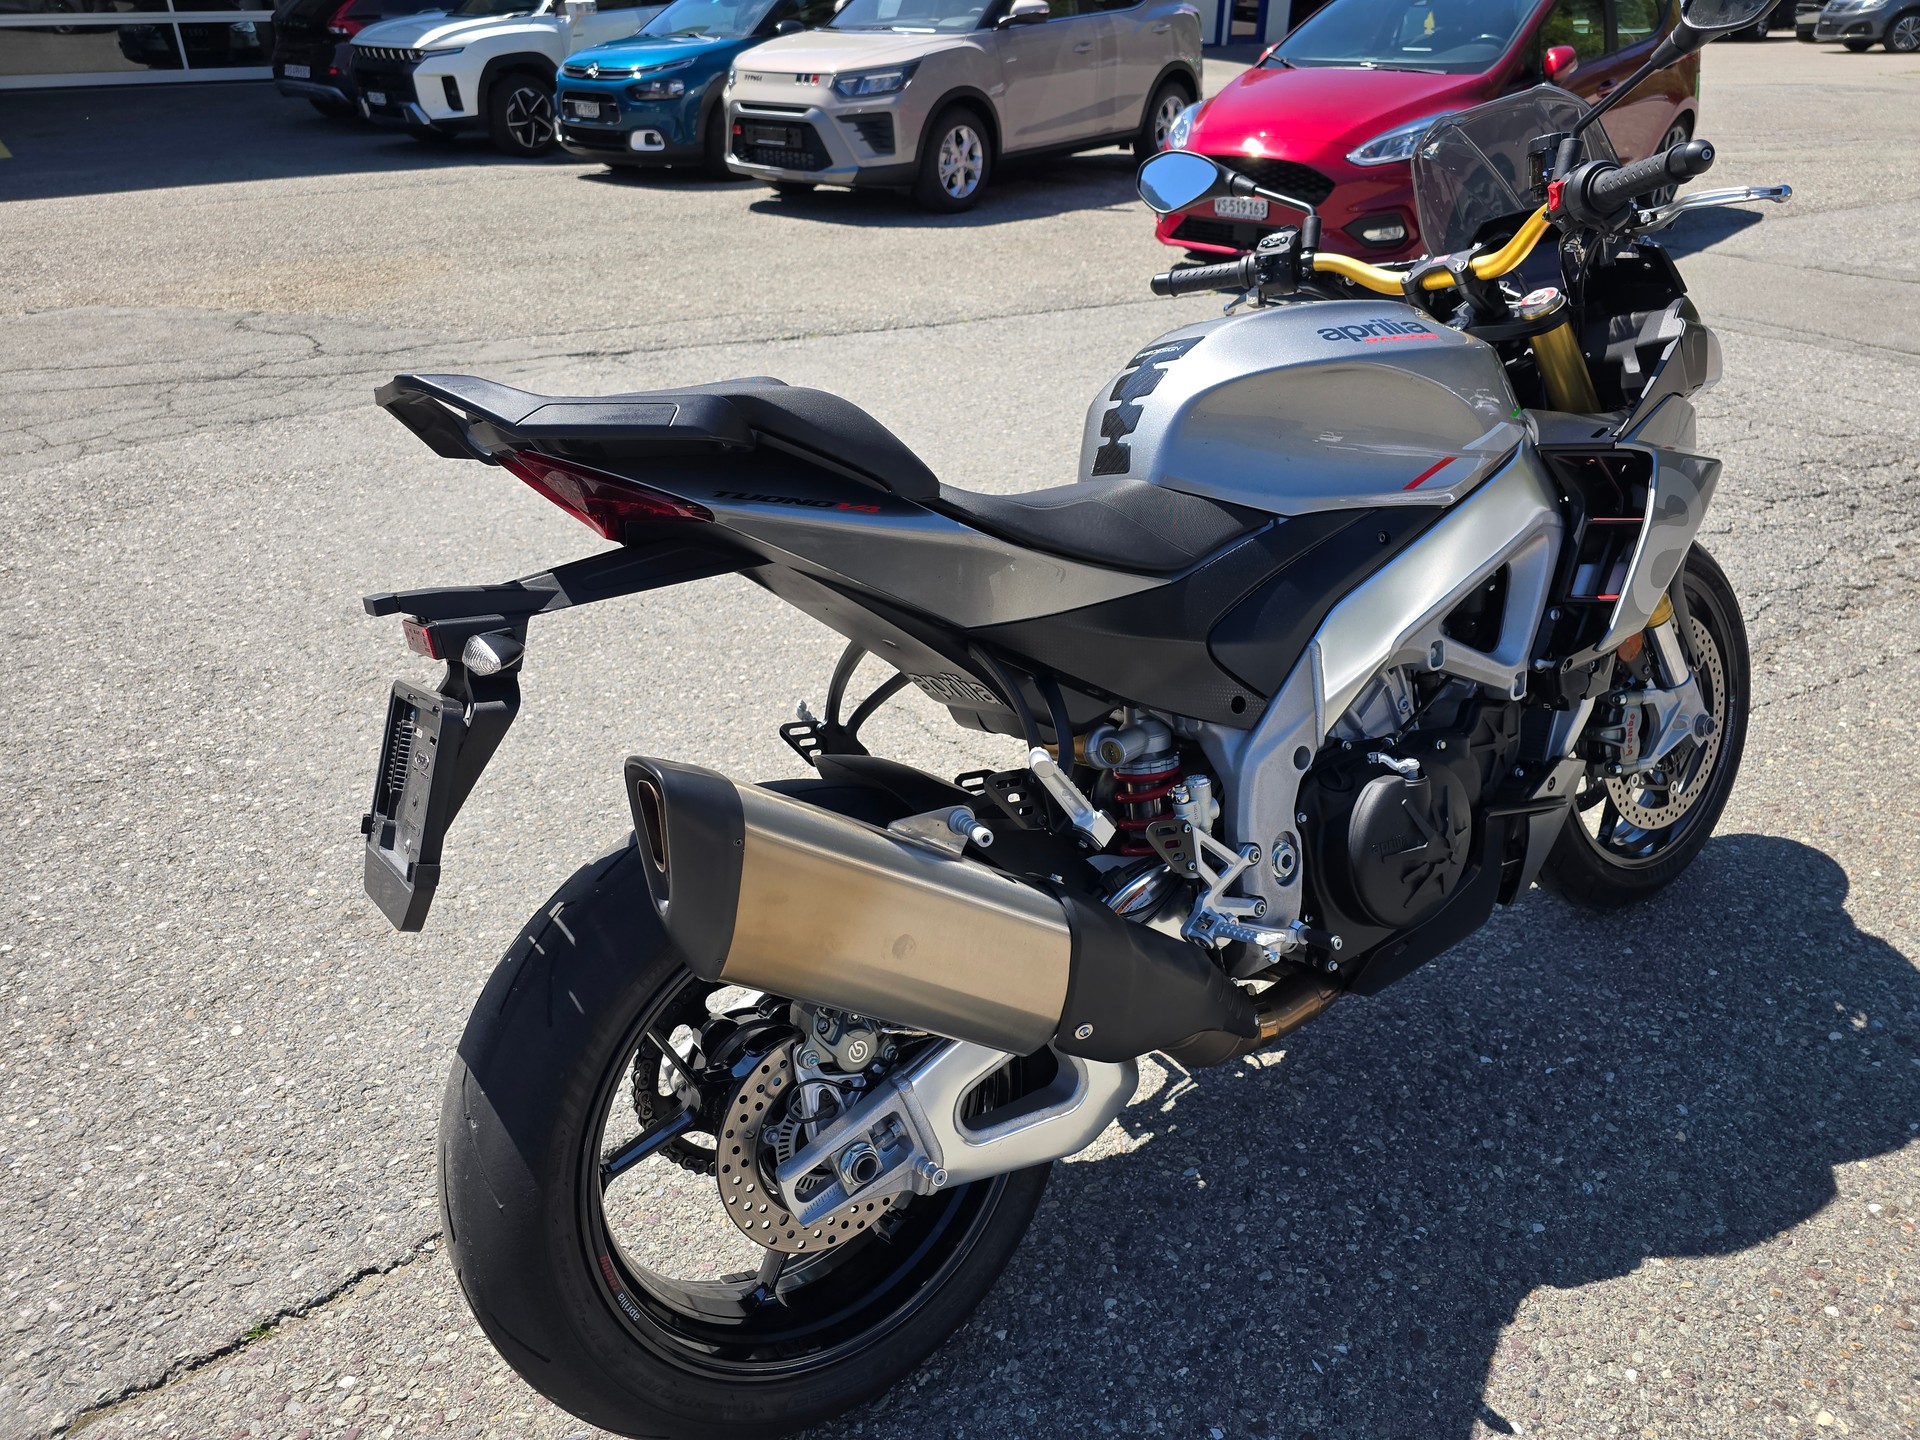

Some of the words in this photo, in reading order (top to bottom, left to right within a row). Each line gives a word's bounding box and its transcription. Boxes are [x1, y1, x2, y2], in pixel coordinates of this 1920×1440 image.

[1316, 318, 1433, 343] aprilia
[712, 490, 838, 508] TUONO
[907, 671, 1004, 706] aprilia
[1625, 712, 1636, 757] brembo
[600, 1255, 620, 1292] racing
[617, 1292, 641, 1322] aprilia
